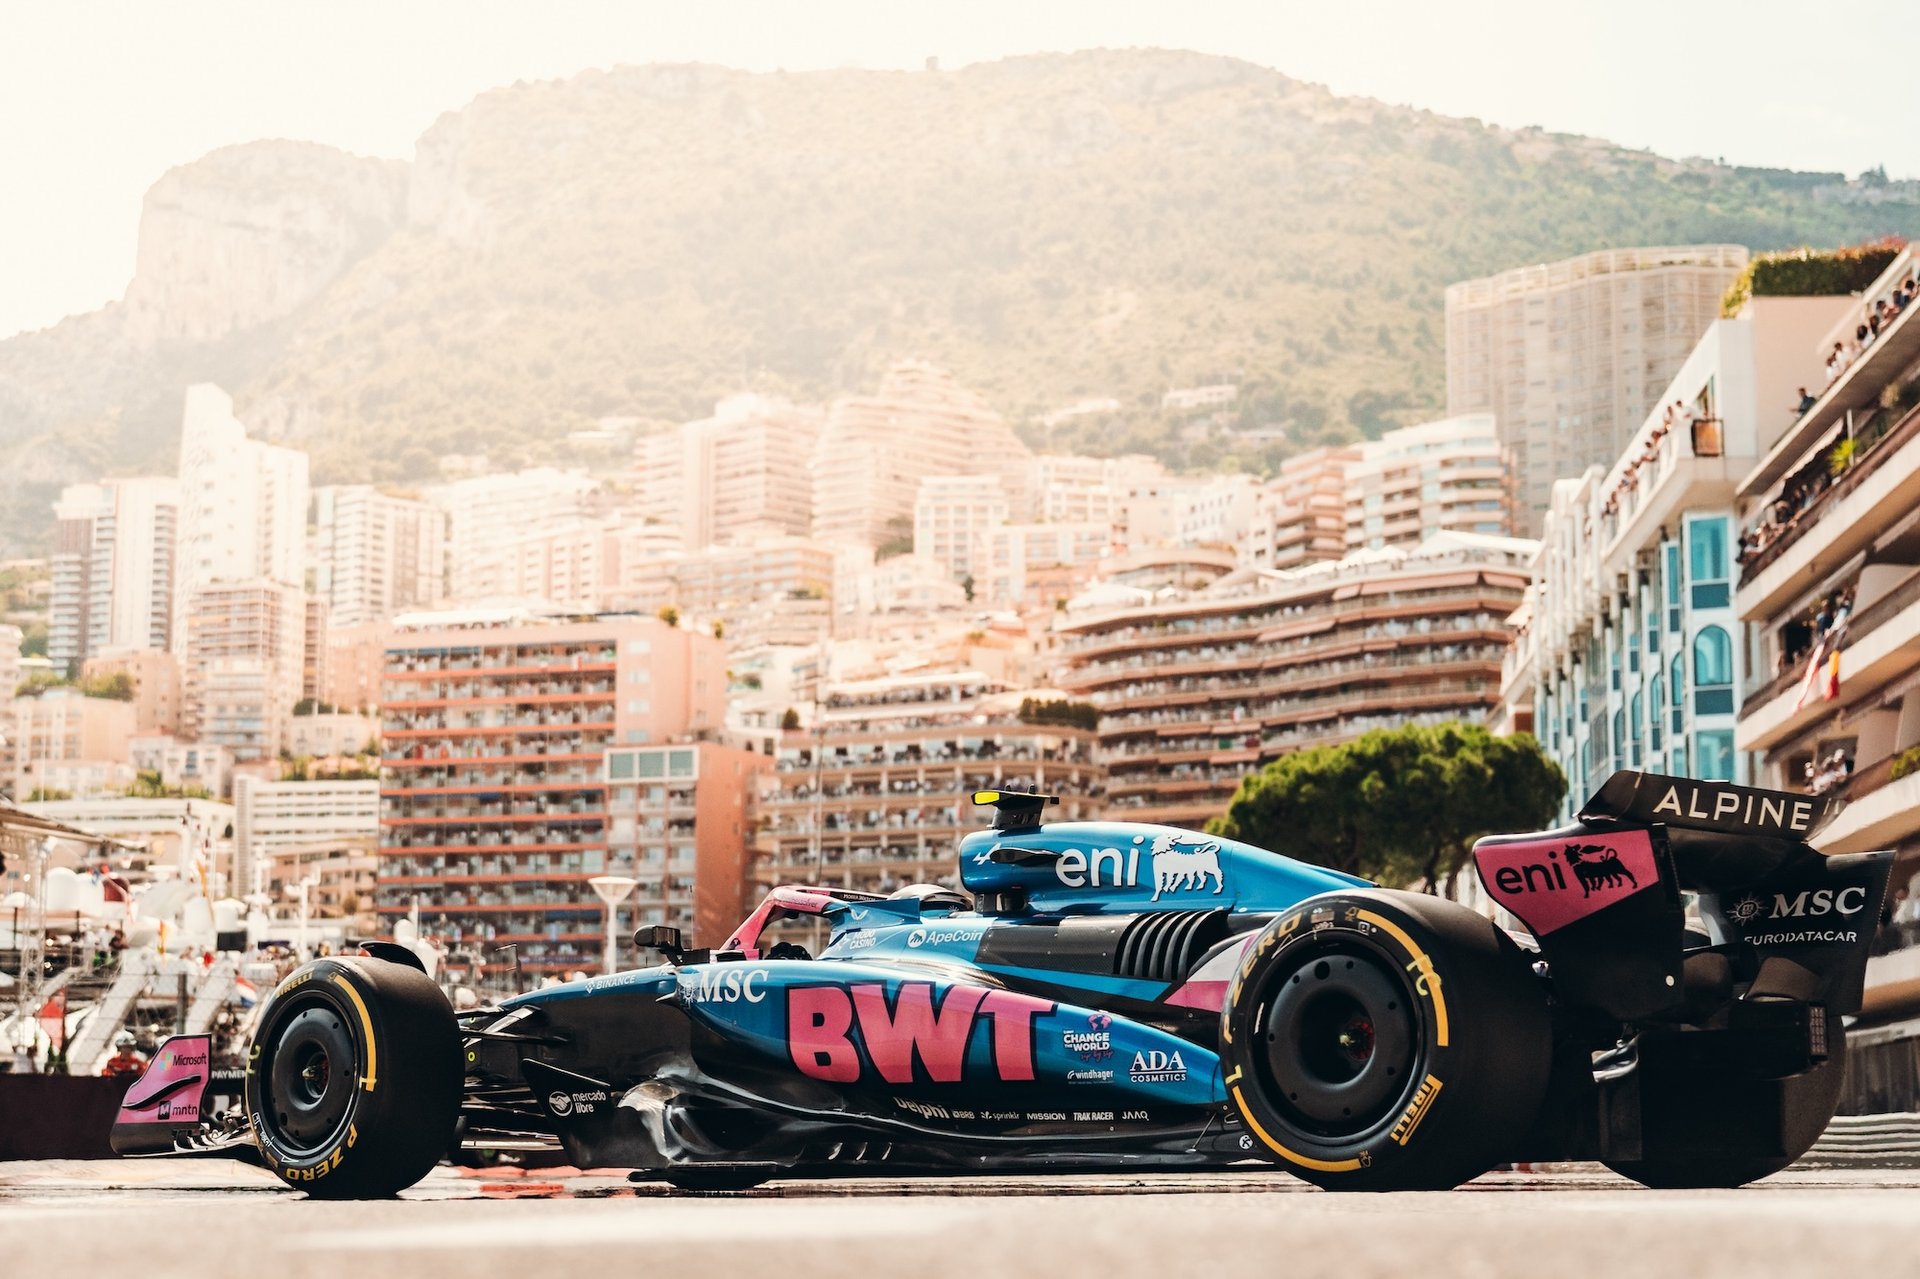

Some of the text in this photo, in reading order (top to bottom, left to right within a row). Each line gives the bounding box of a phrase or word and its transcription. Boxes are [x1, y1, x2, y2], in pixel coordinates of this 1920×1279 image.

[1653, 785, 1813, 831] ALPINE
[1055, 834, 1146, 888] eni
[1496, 850, 1568, 895] eni
[1768, 887, 1866, 919] MSC
[925, 929, 983, 945] ApeCoin
[1232, 911, 1303, 1008] ZERO
[596, 974, 637, 990] BINANCE
[696, 969, 770, 1004] MSC
[788, 983, 1058, 1084] BWT
[1063, 1032, 1110, 1044] CHANGE
[1073, 1042, 1110, 1052] WORLD
[172, 1053, 207, 1067] Microsoft
[1129, 1050, 1187, 1071] ADA
[1075, 1069, 1114, 1081] windhager
[1131, 1073, 1186, 1083] COSMETICS
[572, 1090, 607, 1102] mercado
[172, 1105, 198, 1116] mntn
[575, 1102, 594, 1114] libre
[1390, 1073, 1443, 1146] PIRELLI
[1026, 1112, 1066, 1121] MISSION
[1091, 1112, 1114, 1121] RACER
[285, 1146, 344, 1181] ZERO
